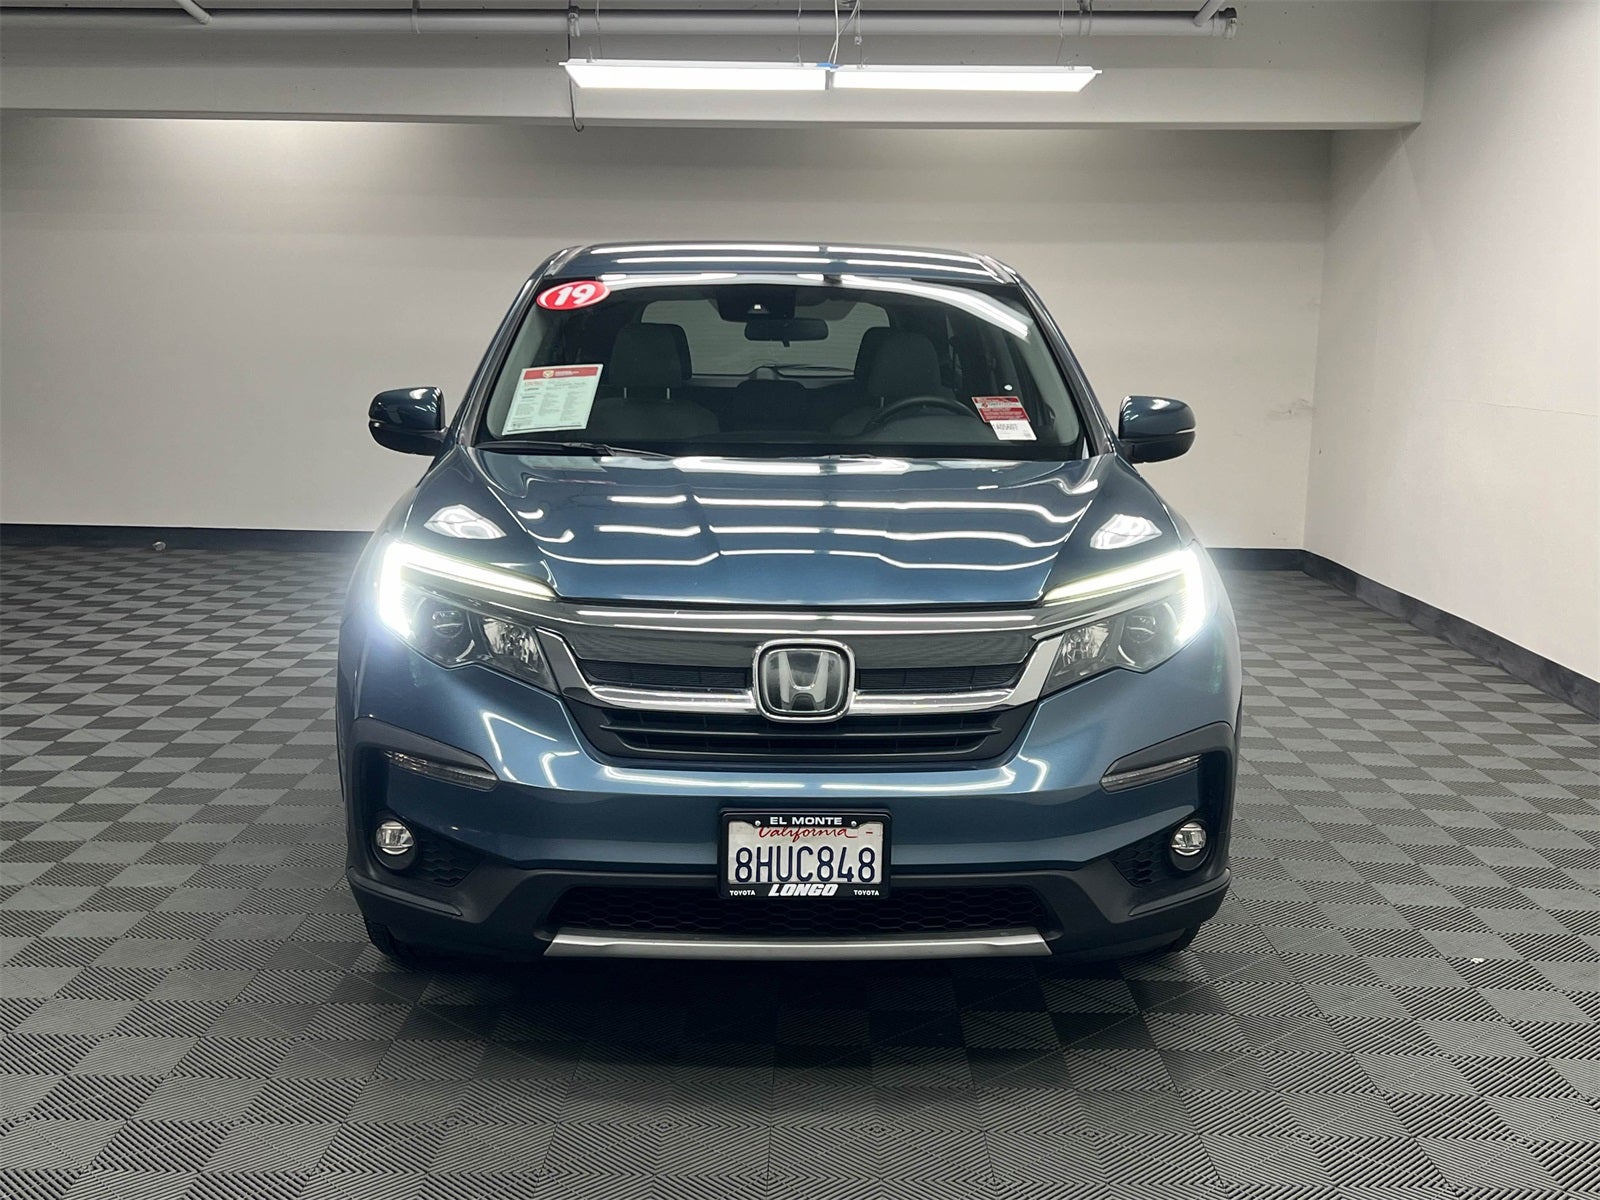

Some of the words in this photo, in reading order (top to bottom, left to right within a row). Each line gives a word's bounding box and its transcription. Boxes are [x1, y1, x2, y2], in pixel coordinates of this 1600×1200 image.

[554, 284, 596, 306] 19
[770, 816, 787, 825] EL
[792, 816, 842, 825] MONTE
[758, 826, 858, 843] California
[735, 845, 875, 882] 8HUC848
[768, 883, 838, 897] LONGO
